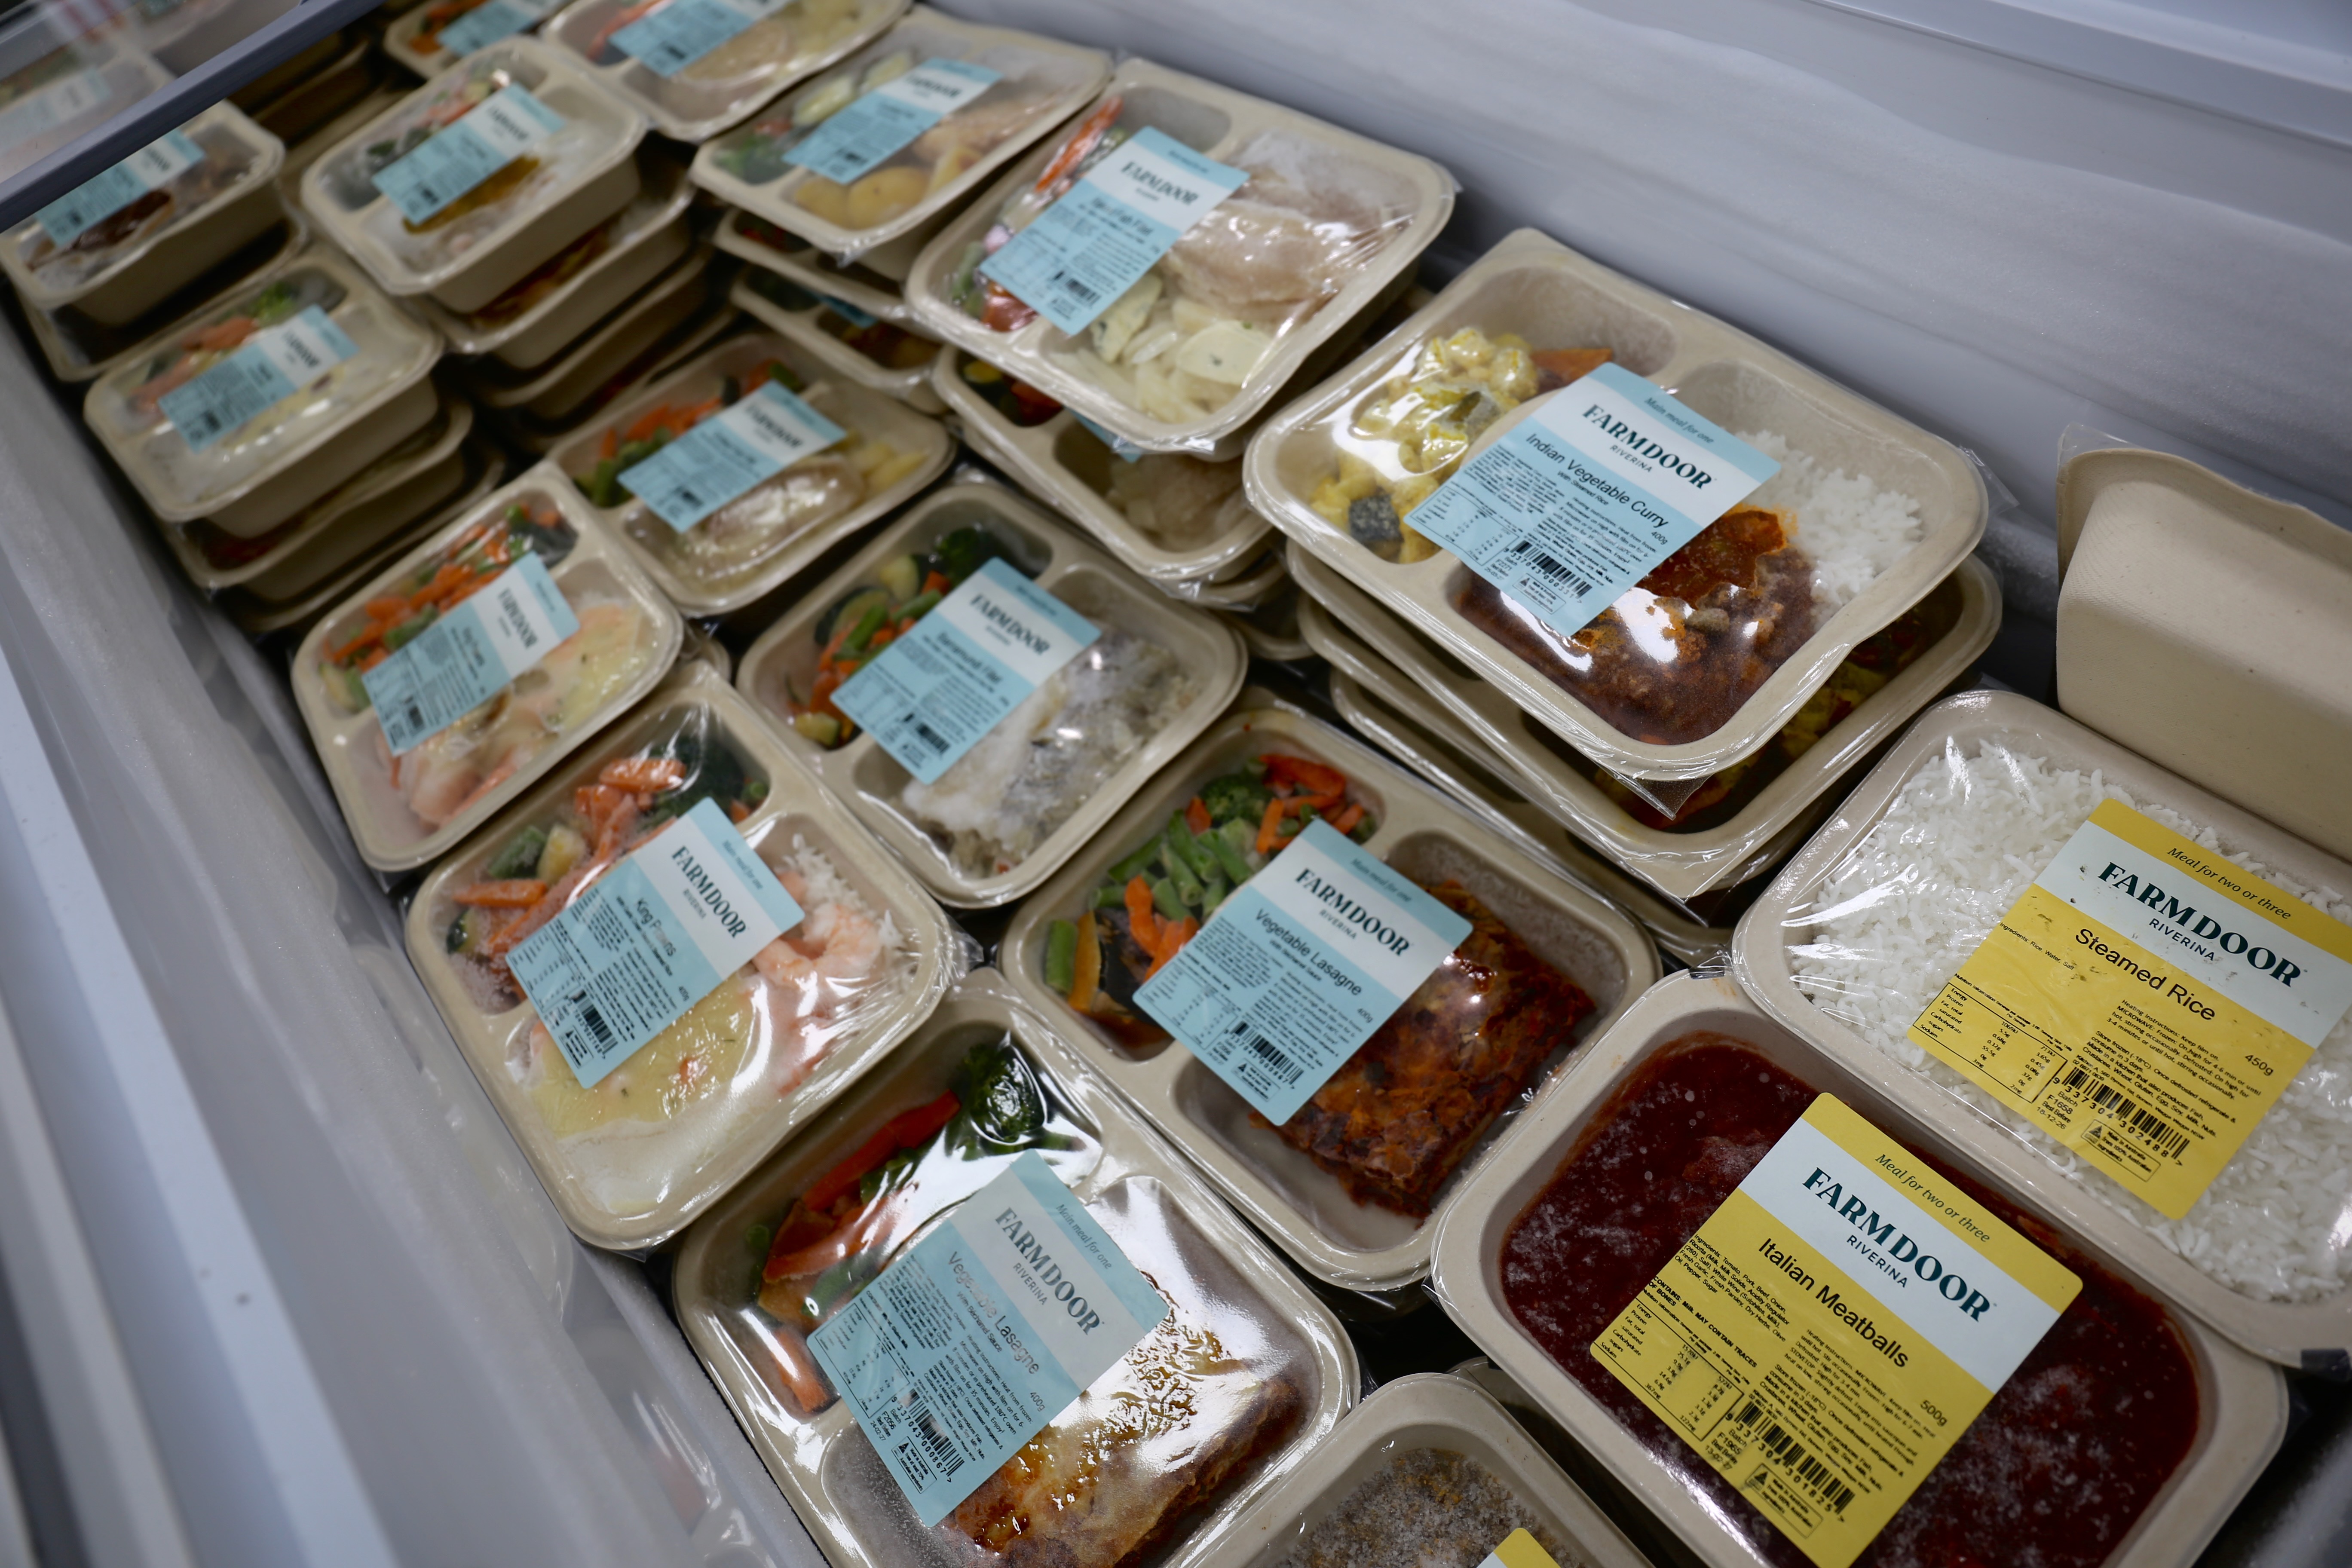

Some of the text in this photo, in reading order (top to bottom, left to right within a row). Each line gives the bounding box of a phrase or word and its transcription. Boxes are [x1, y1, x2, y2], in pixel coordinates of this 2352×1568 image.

[1644, 397, 1714, 443] Main meal for one
[1525, 434, 1669, 529] Indian Vegetable Curry
[1610, 444, 1652, 472] RIVERINA
[1557, 471, 1609, 505] With Steamed Rice
[1650, 531, 1668, 545] 400g
[2167, 847, 2291, 919] Meal for two or three
[635, 898, 654, 925] King
[647, 919, 680, 958] Pns
[1320, 910, 1357, 939] RIVERINA
[2000, 922, 2029, 942] Ingredients:
[2045, 950, 2061, 963] Water,
[2063, 961, 2075, 970] Salt
[2149, 918, 2215, 961] RIVERINA
[1255, 909, 1311, 957] Vegetable
[1309, 953, 1362, 996] Lasagne
[2075, 928, 2216, 1020] Steamed Rice
[1356, 1008, 1373, 1023] 400g
[2121, 1000, 2144, 1016] Heating
[2145, 1014, 2180, 1037] Instructions:
[2180, 1035, 2196, 1046] Keep
[2197, 1045, 2209, 1054] film
[2111, 1011, 2249, 1098] hot, stirring occasionally. Defrosted: On high for
[2117, 1005, 2155, 1030] MICROWAVE:
[2156, 1029, 2177, 1044] Frozen:
[2187, 1048, 2202, 1059] high
[2224, 1072, 2236, 1081] min
[2246, 1085, 2261, 1096] until
[2244, 1054, 2274, 1076] 450g
[2036, 1106, 2066, 1129] 18-12-26
[2046, 1094, 2073, 1114] F1658
[2058, 1091, 2078, 1107] Batch
[1875, 1153, 1990, 1242] Meal for two or three
[1056, 1204, 1112, 1269] Main meal for one
[1675, 1255, 1683, 1264] Oil,
[1847, 1234, 1908, 1287] RIVERINA
[1013, 1262, 1047, 1305] RIVERINA
[1647, 1280, 1676, 1306] OF BONES
[1679, 1250, 1694, 1263] Fresh
[1710, 1275, 1724, 1289] Fresh
[1724, 1288, 1744, 1307] Parsley,
[1745, 1305, 1755, 1316] Dry
[1684, 1244, 1780, 1328] (260), Salt), White Wine (Sulphites, Milk),
[1689, 1239, 1706, 1255] Ricotta
[1720, 1265, 1730, 1275] Milk
[1747, 1289, 1765, 1305] Acidity
[1764, 1303, 1789, 1325] Regulator
[1722, 1257, 1741, 1275] Tomato,
[1742, 1274, 1755, 1288] Pork,
[1756, 1286, 1770, 1299] Beef,
[957, 1292, 969, 1307] With
[987, 1333, 1002, 1352] Sauce
[1758, 1238, 1909, 1368] Italian Meatballs
[993, 1315, 1040, 1375] Lasagne
[1695, 1312, 1708, 1324] MAY
[1708, 1324, 1733, 1347] CONTAIN
[1734, 1346, 1757, 1367] TRACES
[945, 1354, 954, 1365] with
[953, 1364, 961, 1375] film
[970, 1389, 977, 1397] 35
[975, 1397, 990, 1418] minutes.
[990, 1417, 1004, 1433] Enjoy!
[966, 1335, 1033, 1424] Heating Instructions: Heat from frozen:
[1029, 1391, 1045, 1412] 400g
[870, 1420, 886, 1441] 24-02-27
[882, 1411, 896, 1430] F2056
[890, 1409, 901, 1424] Batch
[1920, 1400, 1948, 1427] 500g
